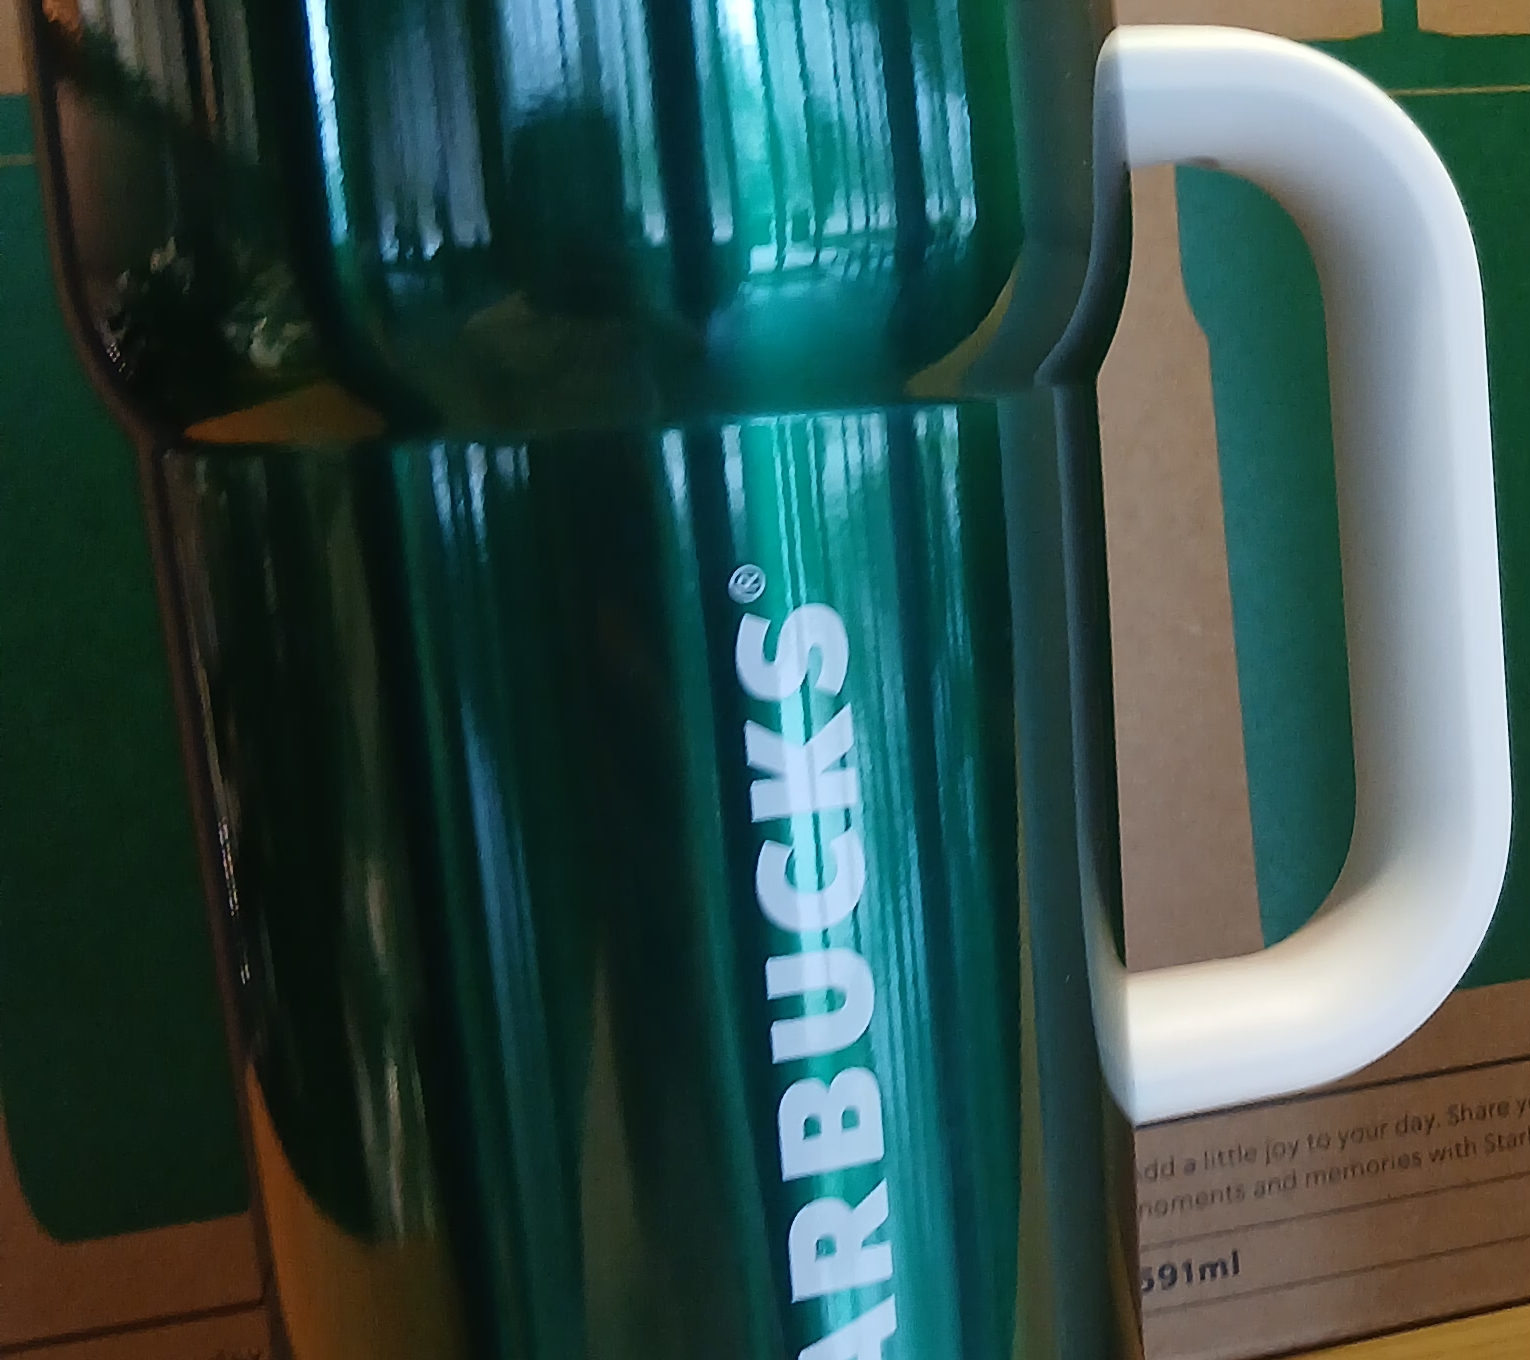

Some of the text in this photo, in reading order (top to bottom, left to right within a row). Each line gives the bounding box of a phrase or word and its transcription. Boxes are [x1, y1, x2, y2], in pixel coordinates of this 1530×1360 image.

[1184, 1158, 1197, 1176] a
[1204, 1144, 1257, 1171] little
[1265, 1138, 1300, 1166] joy
[1307, 1132, 1331, 1151] to
[1338, 1121, 1388, 1152] your
[1448, 1100, 1510, 1127] Share
[1254, 1169, 1297, 1198] and
[1306, 1151, 1422, 1187] memories
[1429, 1136, 1477, 1163] with
